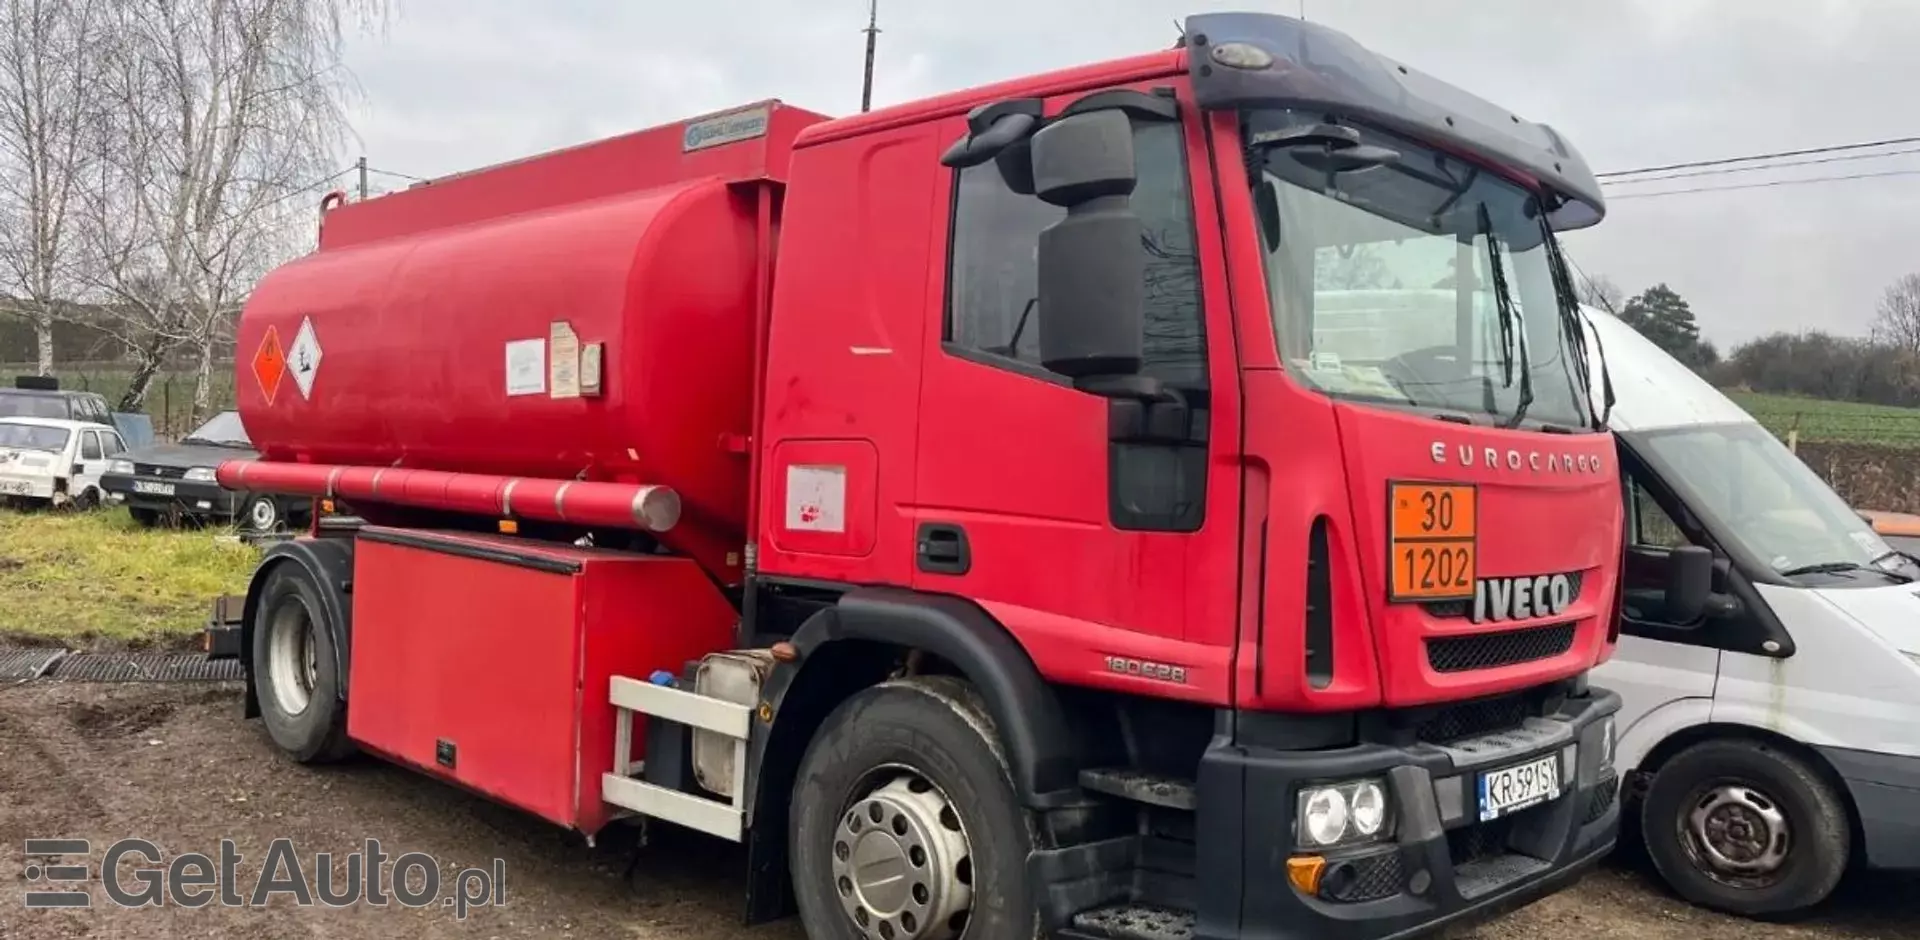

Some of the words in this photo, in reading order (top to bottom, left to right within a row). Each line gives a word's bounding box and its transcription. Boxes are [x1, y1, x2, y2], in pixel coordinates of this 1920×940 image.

[1431, 441, 1600, 474] EUROCARGO
[1421, 491, 1453, 531] 30
[1405, 547, 1469, 590] 1202
[1474, 574, 1570, 624] IVECO
[1104, 655, 1185, 683] 180E28
[1489, 772, 1513, 807] KR
